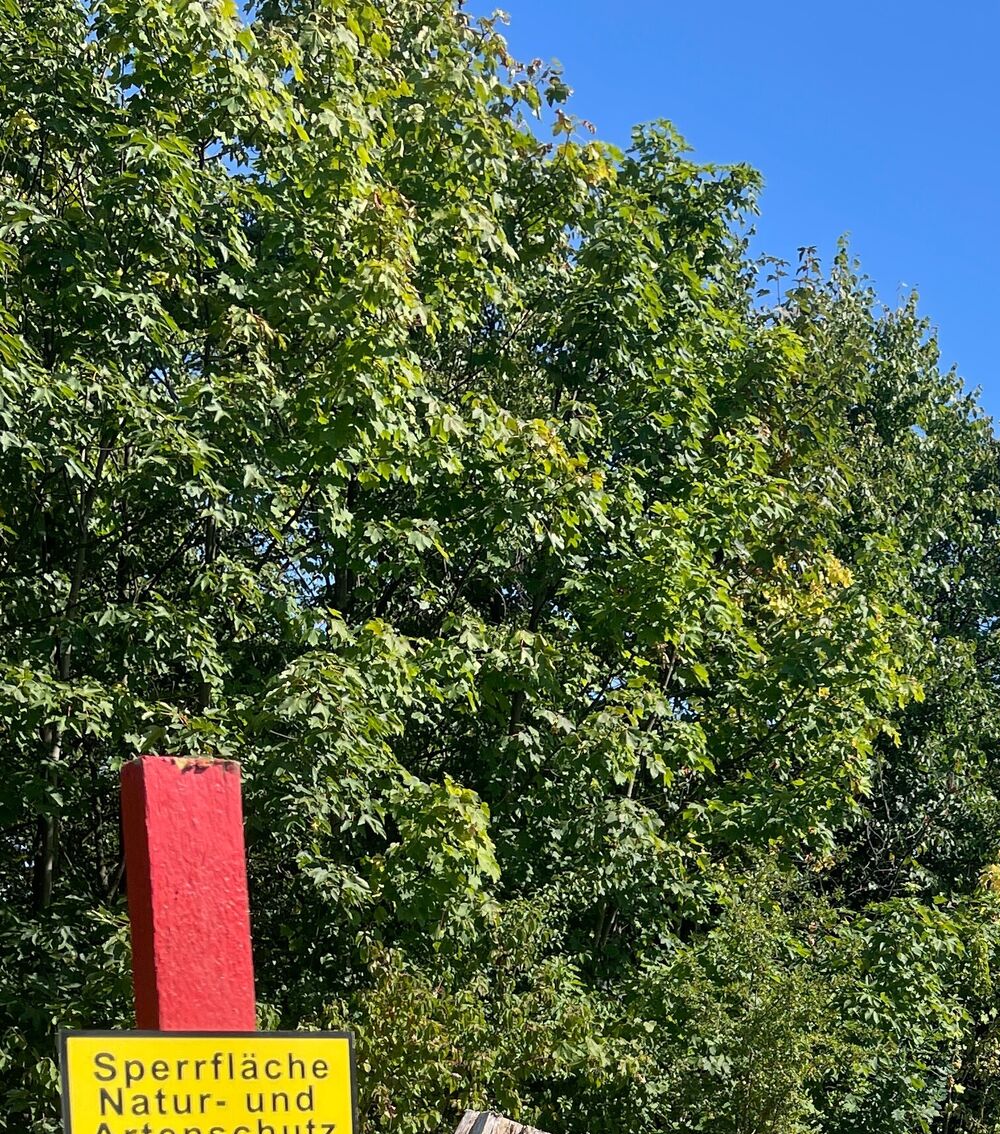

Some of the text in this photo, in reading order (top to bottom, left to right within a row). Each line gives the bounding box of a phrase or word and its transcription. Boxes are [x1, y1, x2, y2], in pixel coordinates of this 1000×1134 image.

[93, 1052, 329, 1088] Sperrfläche
[100, 1085, 314, 1116] Natur- und
